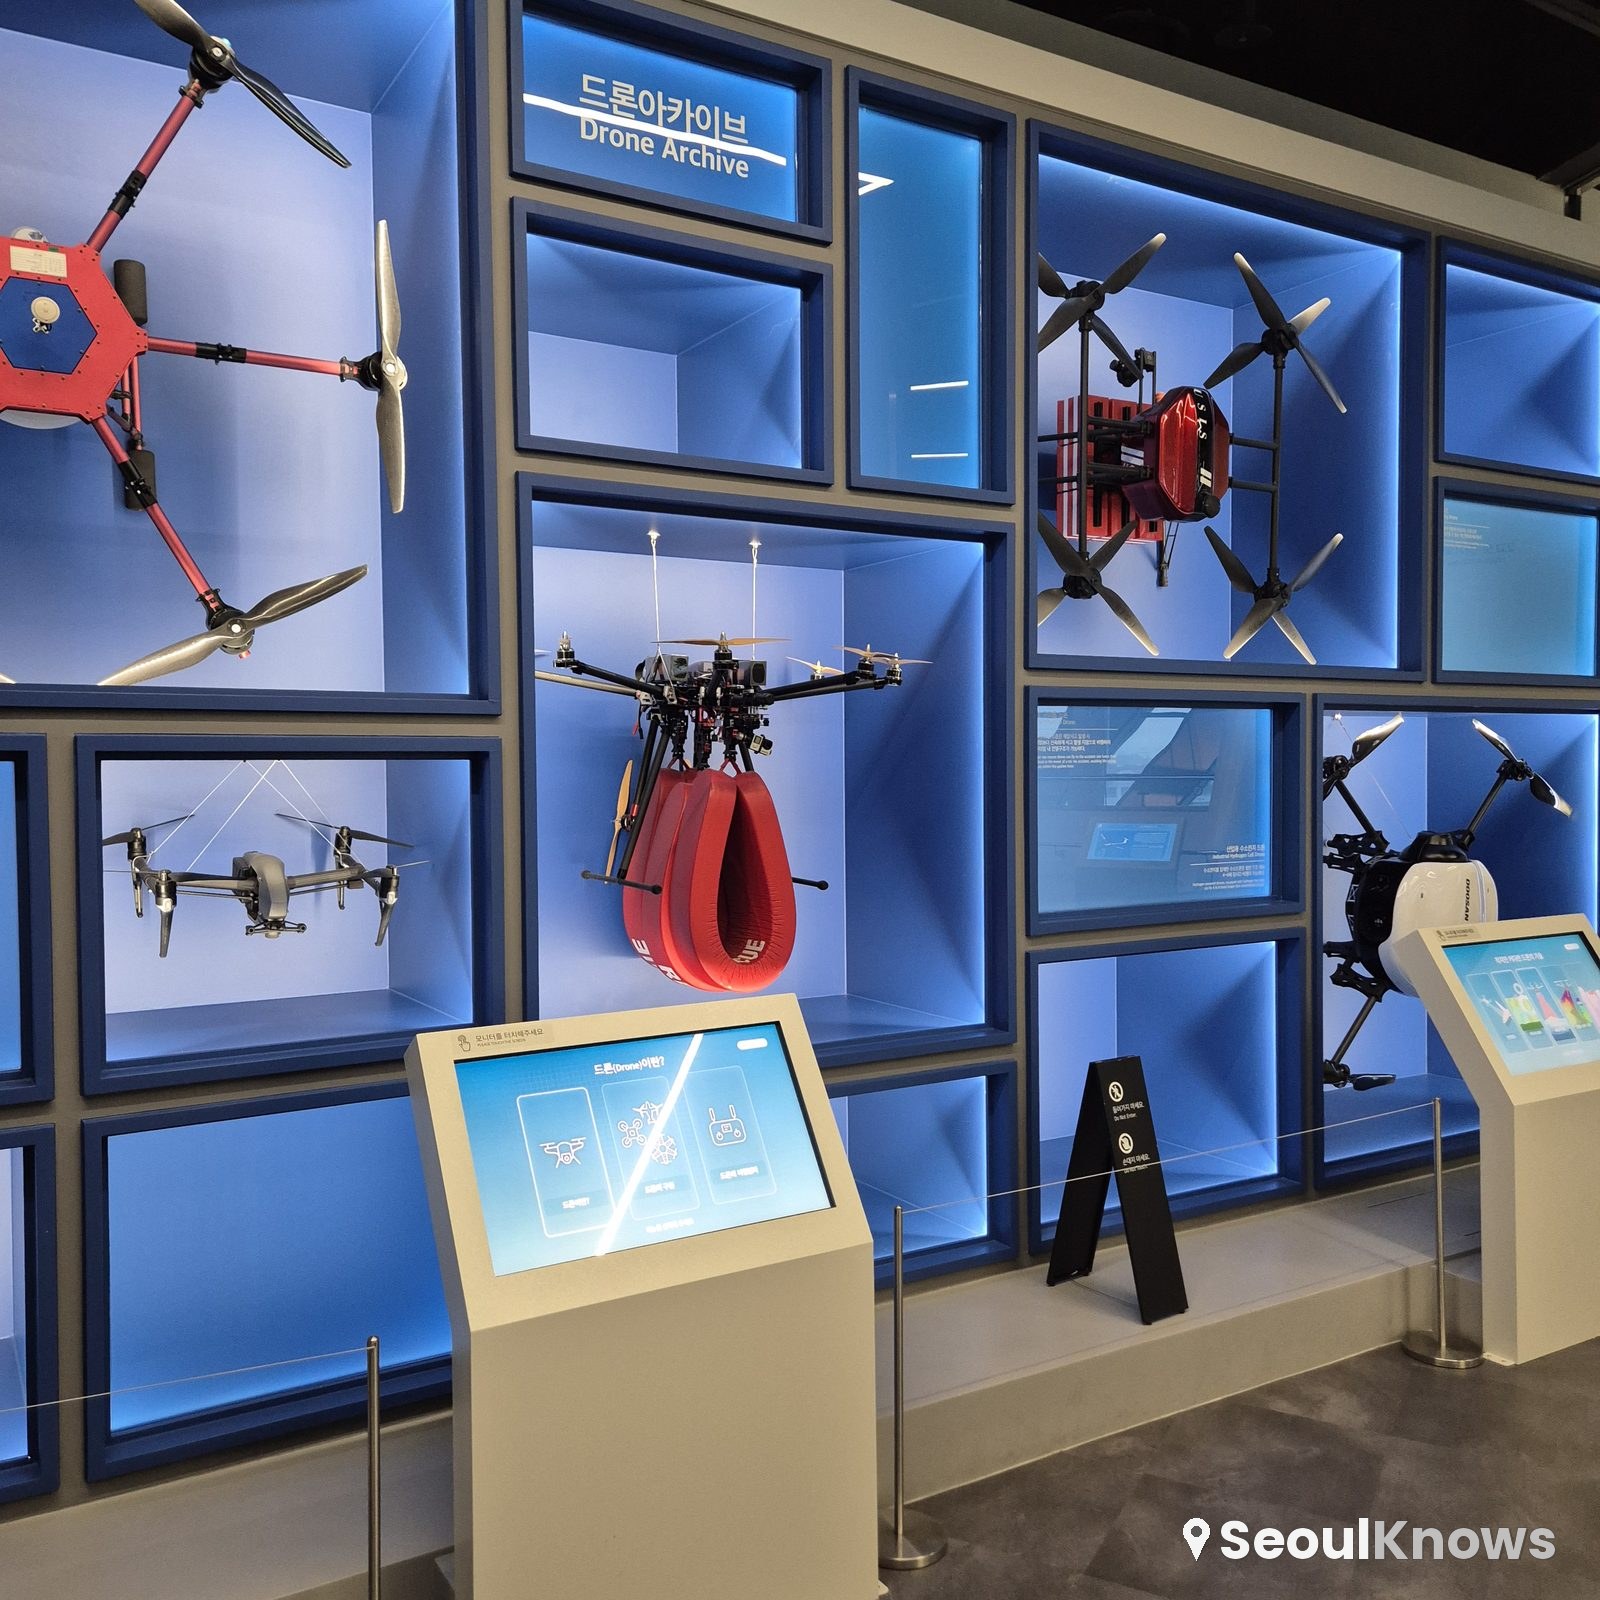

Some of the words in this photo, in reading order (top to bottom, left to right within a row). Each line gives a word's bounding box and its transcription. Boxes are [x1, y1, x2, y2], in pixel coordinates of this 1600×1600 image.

[579, 73, 749, 144] 드론아카이브
[579, 116, 655, 155] Drone
[661, 136, 750, 179] Archive
[1464, 878, 1472, 922] DOOSAN
[475, 1032, 503, 1042] 모니터를
[593, 1055, 666, 1076] 드론(Drone)이란?
